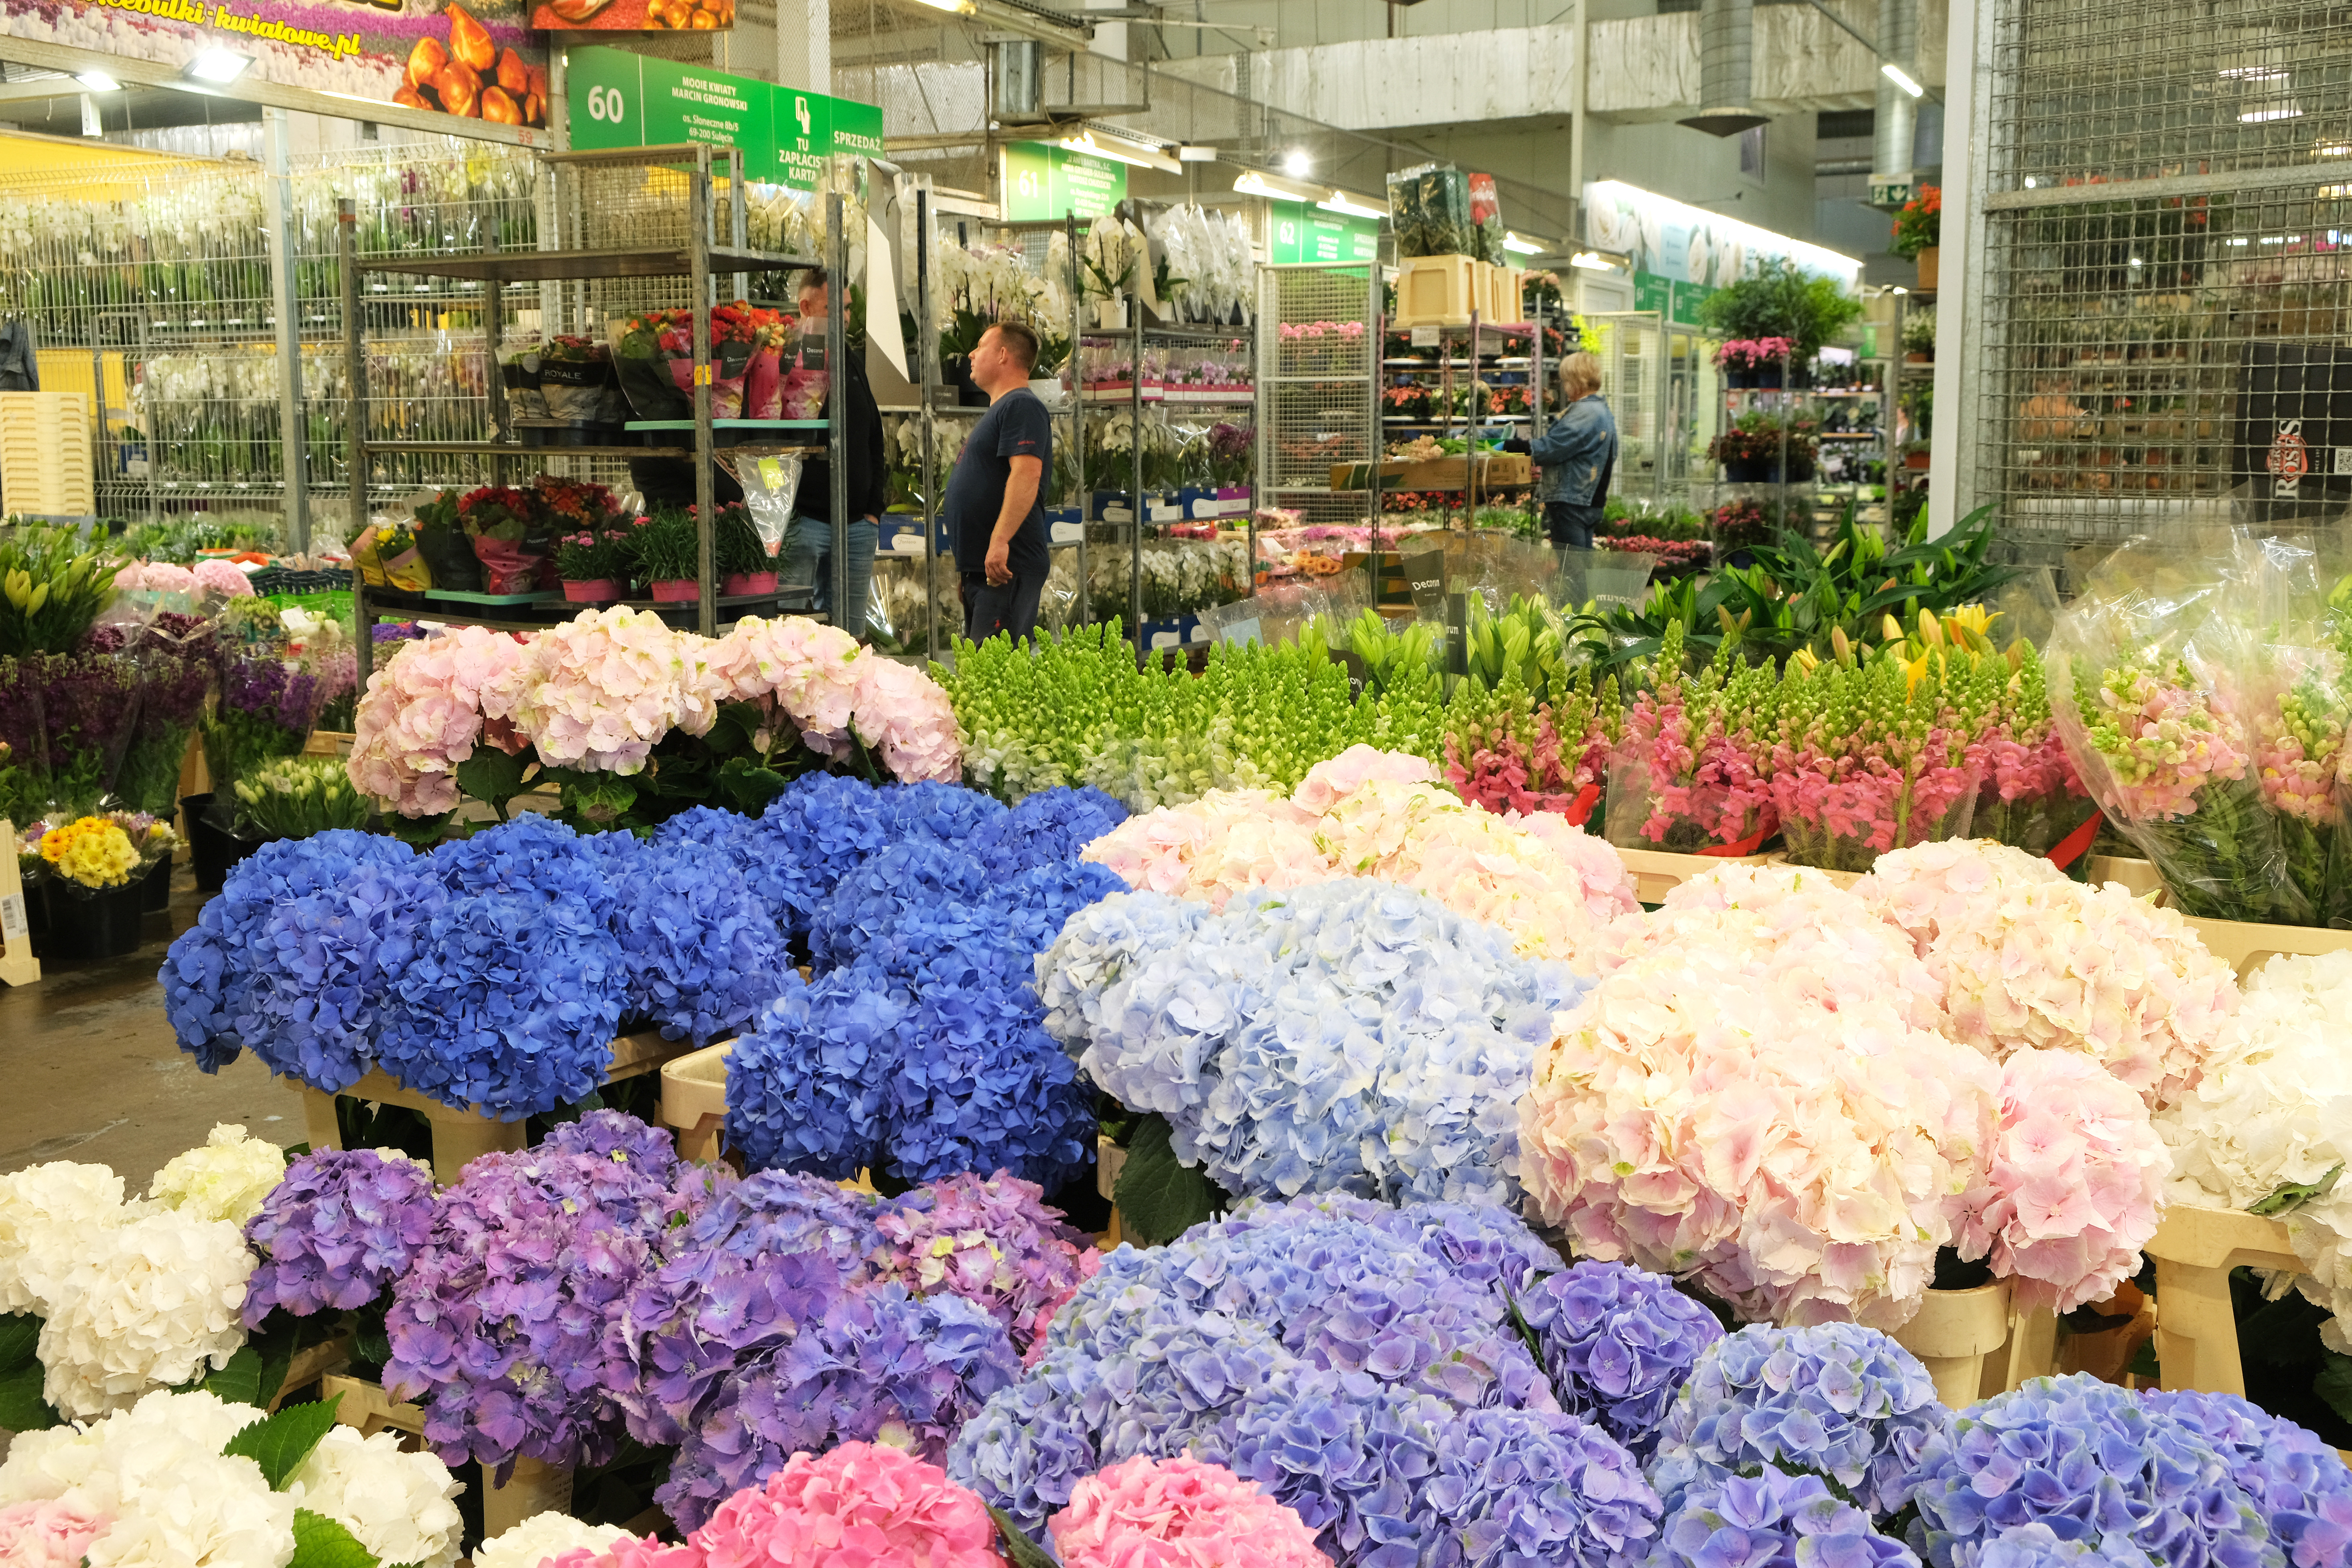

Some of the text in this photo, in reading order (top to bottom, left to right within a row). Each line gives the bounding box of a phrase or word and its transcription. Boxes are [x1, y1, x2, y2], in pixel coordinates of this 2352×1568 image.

[682, 76, 737, 97] MOOIE KWIATY
[588, 85, 623, 123] 60
[672, 87, 747, 111] MARCIN GRONOWSKI
[693, 114, 724, 128] Słoneczne
[725, 120, 739, 132] 8b/5
[518, 130, 533, 144] 59
[689, 127, 733, 143] 69-200 Sulęcin
[796, 137, 809, 152] TU
[834, 130, 880, 152] SPRZEDAŻ
[779, 150, 824, 168] ZAPŁACIS
[1019, 169, 1038, 198] 61
[1280, 221, 1295, 245] 62
[544, 369, 582, 379] ROYALE
[2275, 420, 2302, 498] ROSES
